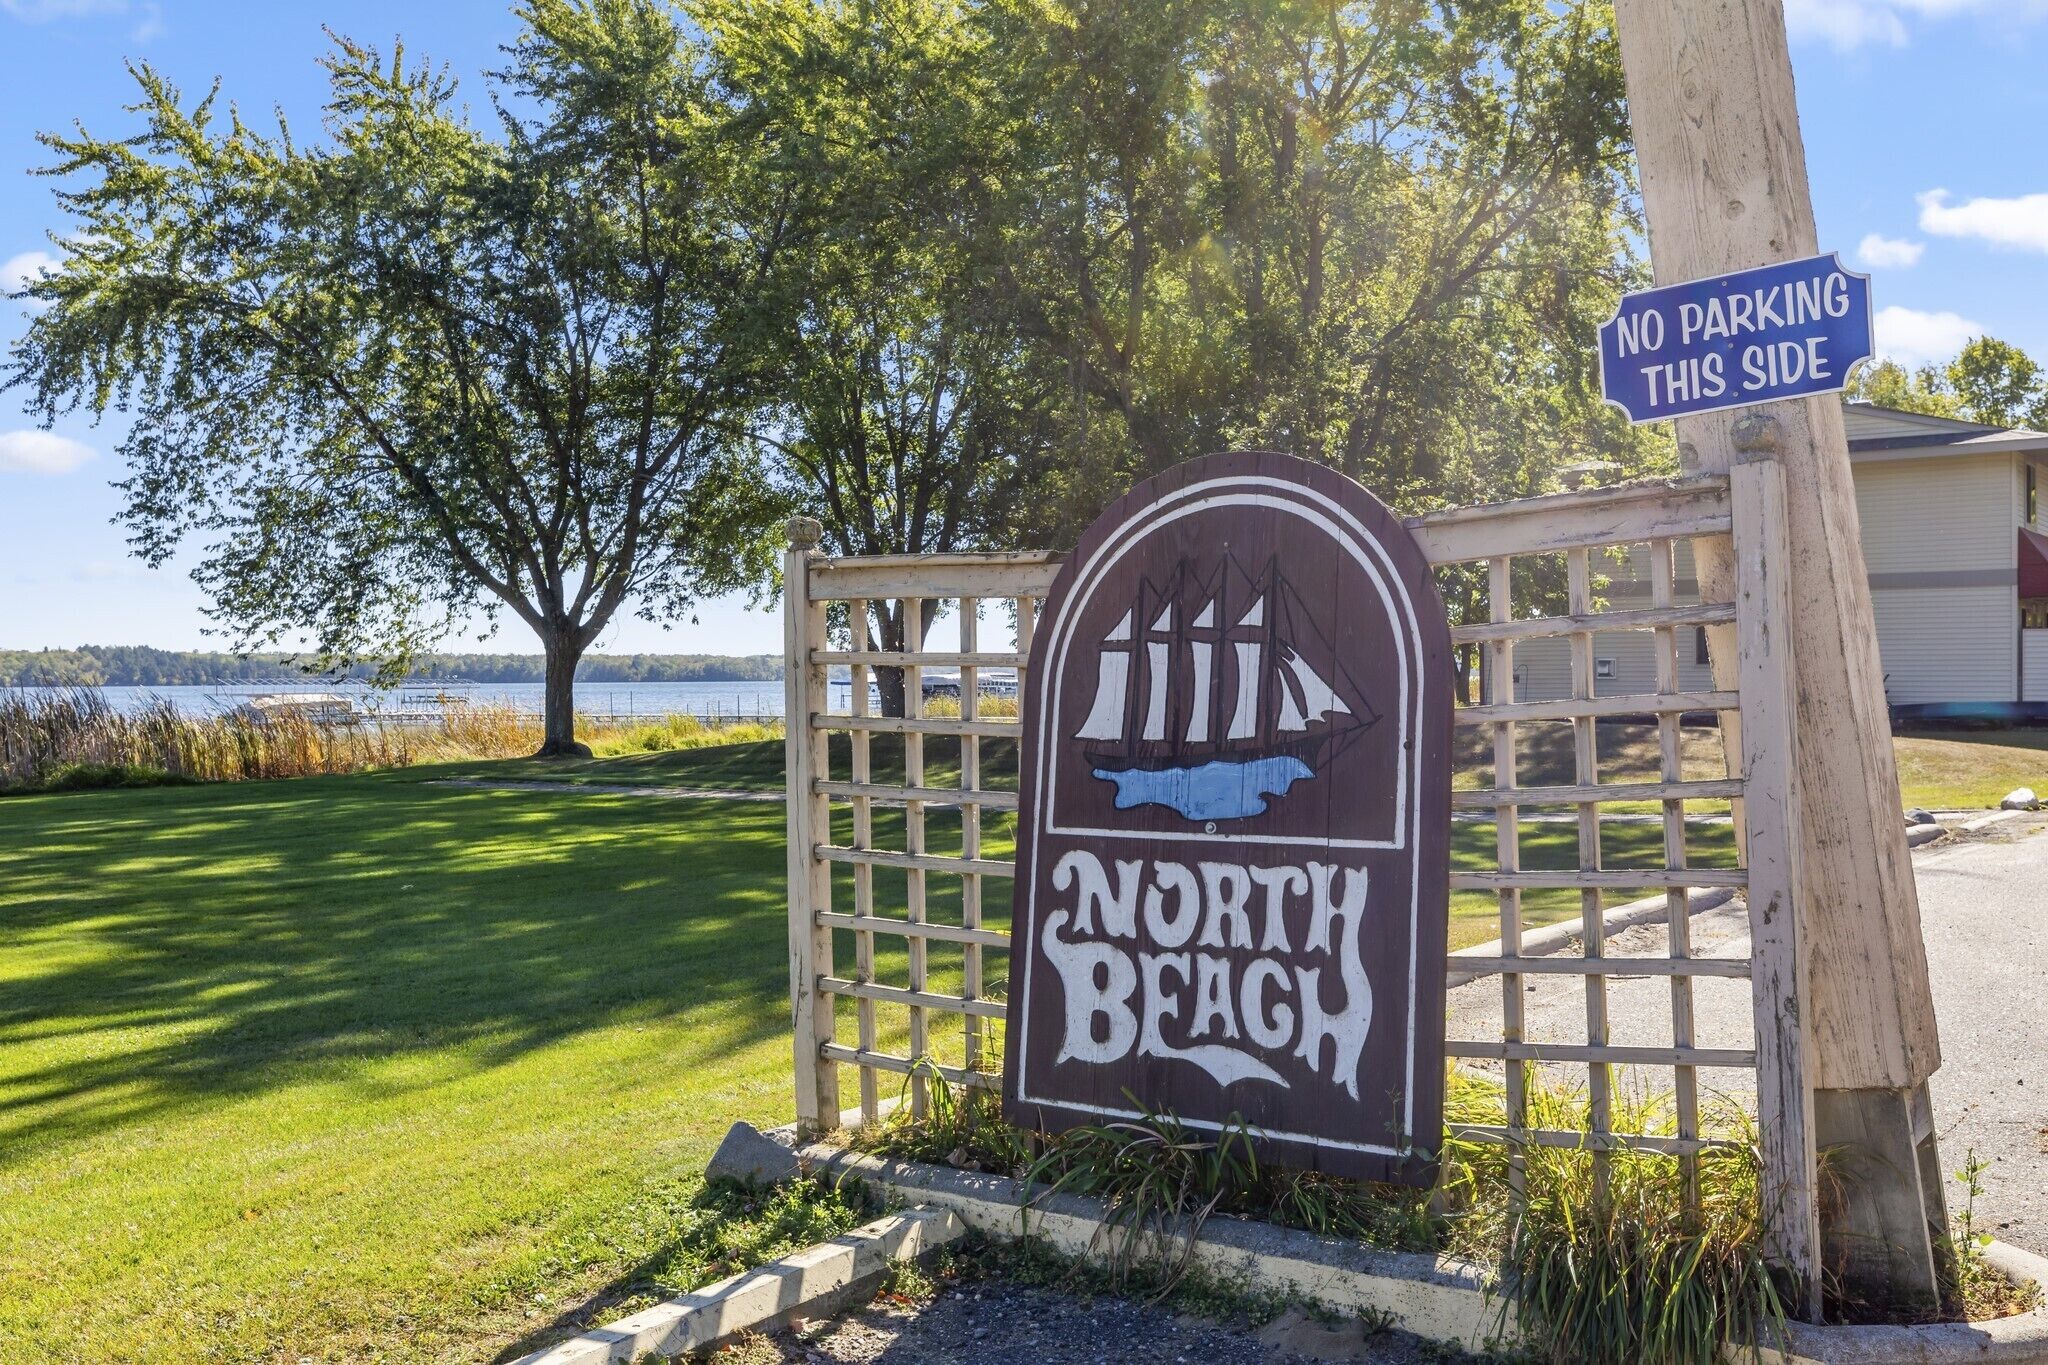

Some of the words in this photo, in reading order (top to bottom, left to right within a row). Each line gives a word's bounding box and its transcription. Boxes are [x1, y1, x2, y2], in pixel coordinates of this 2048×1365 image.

[1617, 309, 1665, 358] NO
[1679, 272, 1850, 344] PARKING
[1641, 352, 1727, 407] THIS
[1742, 336, 1832, 391] SIDE
[1052, 849, 1368, 956] NORTH
[1041, 908, 1373, 1102] BEACH
